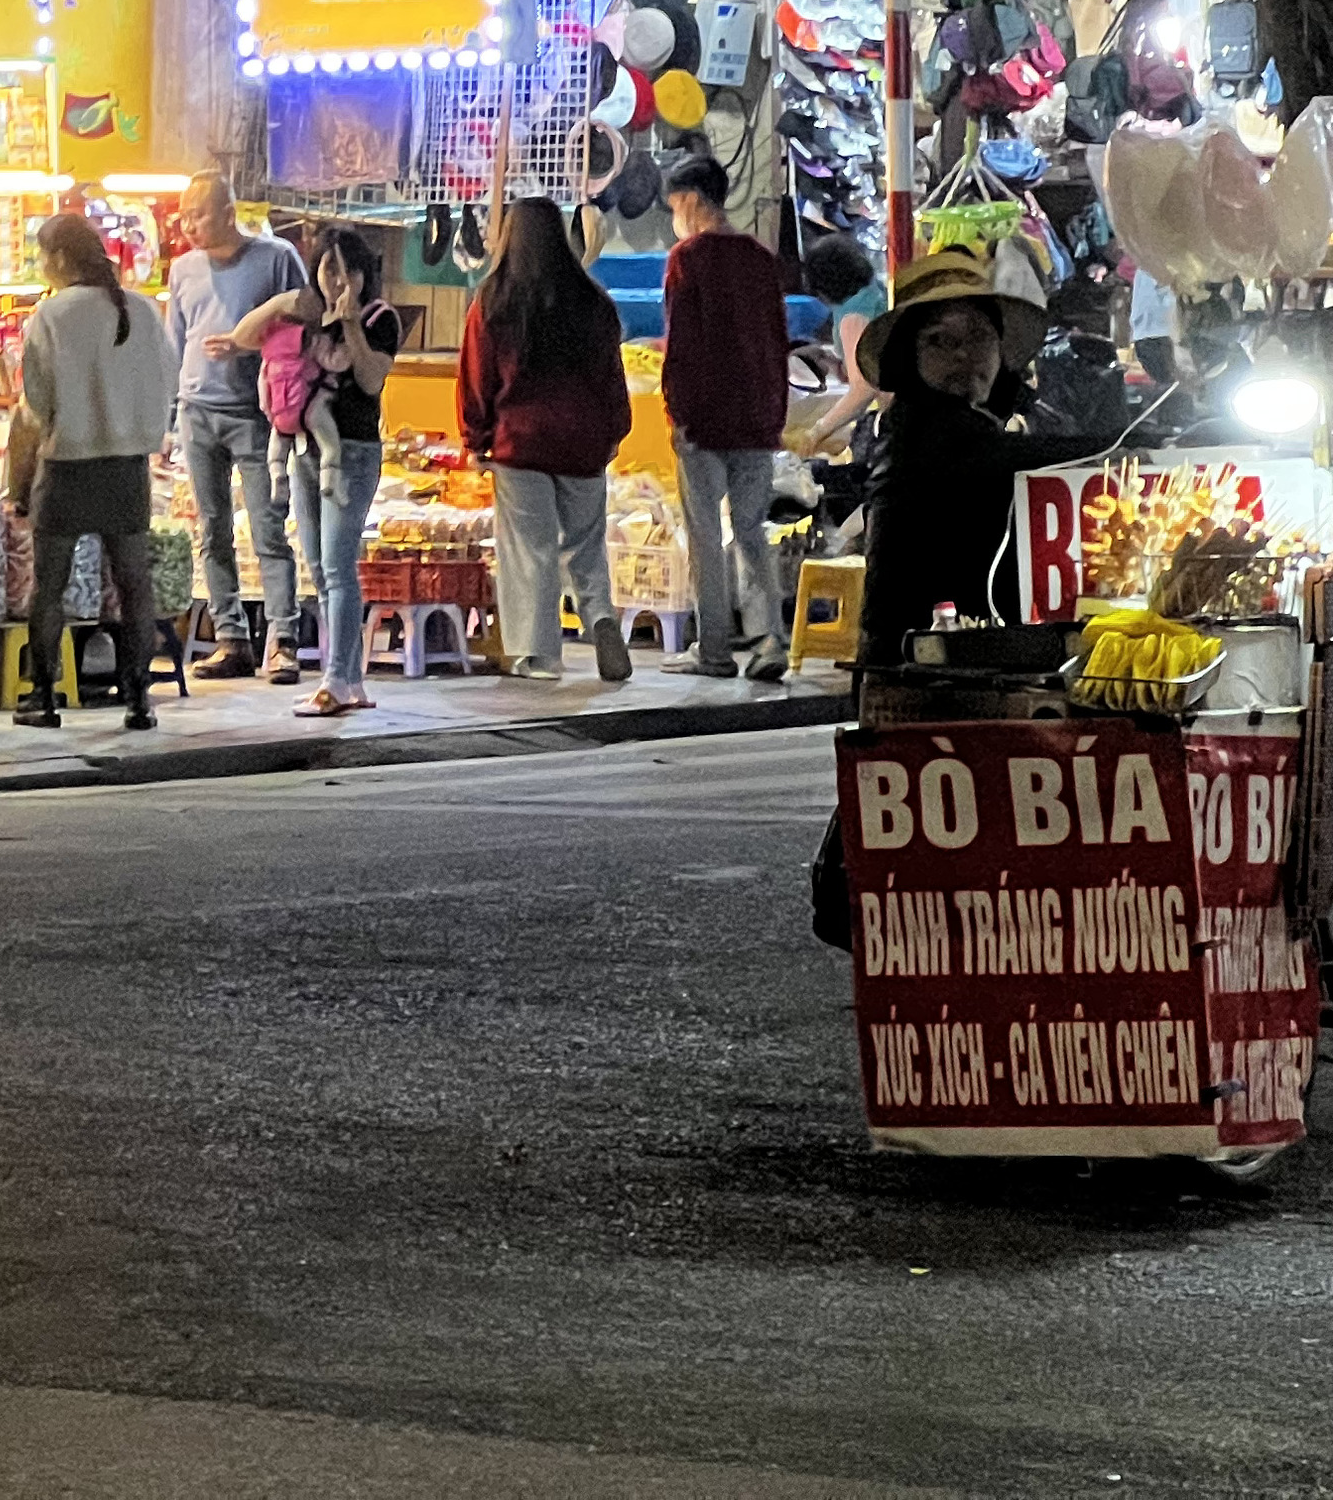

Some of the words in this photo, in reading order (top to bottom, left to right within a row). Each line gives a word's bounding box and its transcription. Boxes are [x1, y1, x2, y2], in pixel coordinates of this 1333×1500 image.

[857, 736, 978, 849] BÒ
[1008, 735, 1171, 846] BÍA
[861, 872, 950, 976] BÁNH
[954, 870, 1064, 975] TRÁNG
[1072, 867, 1190, 975] NƯỚNG
[870, 1004, 922, 1107] XÚC
[926, 1004, 989, 1106] XÍCH
[1009, 1004, 1048, 1106] CÁ
[1048, 1002, 1112, 1105] VIÊN
[1116, 1001, 1200, 1105] CHIÊN
